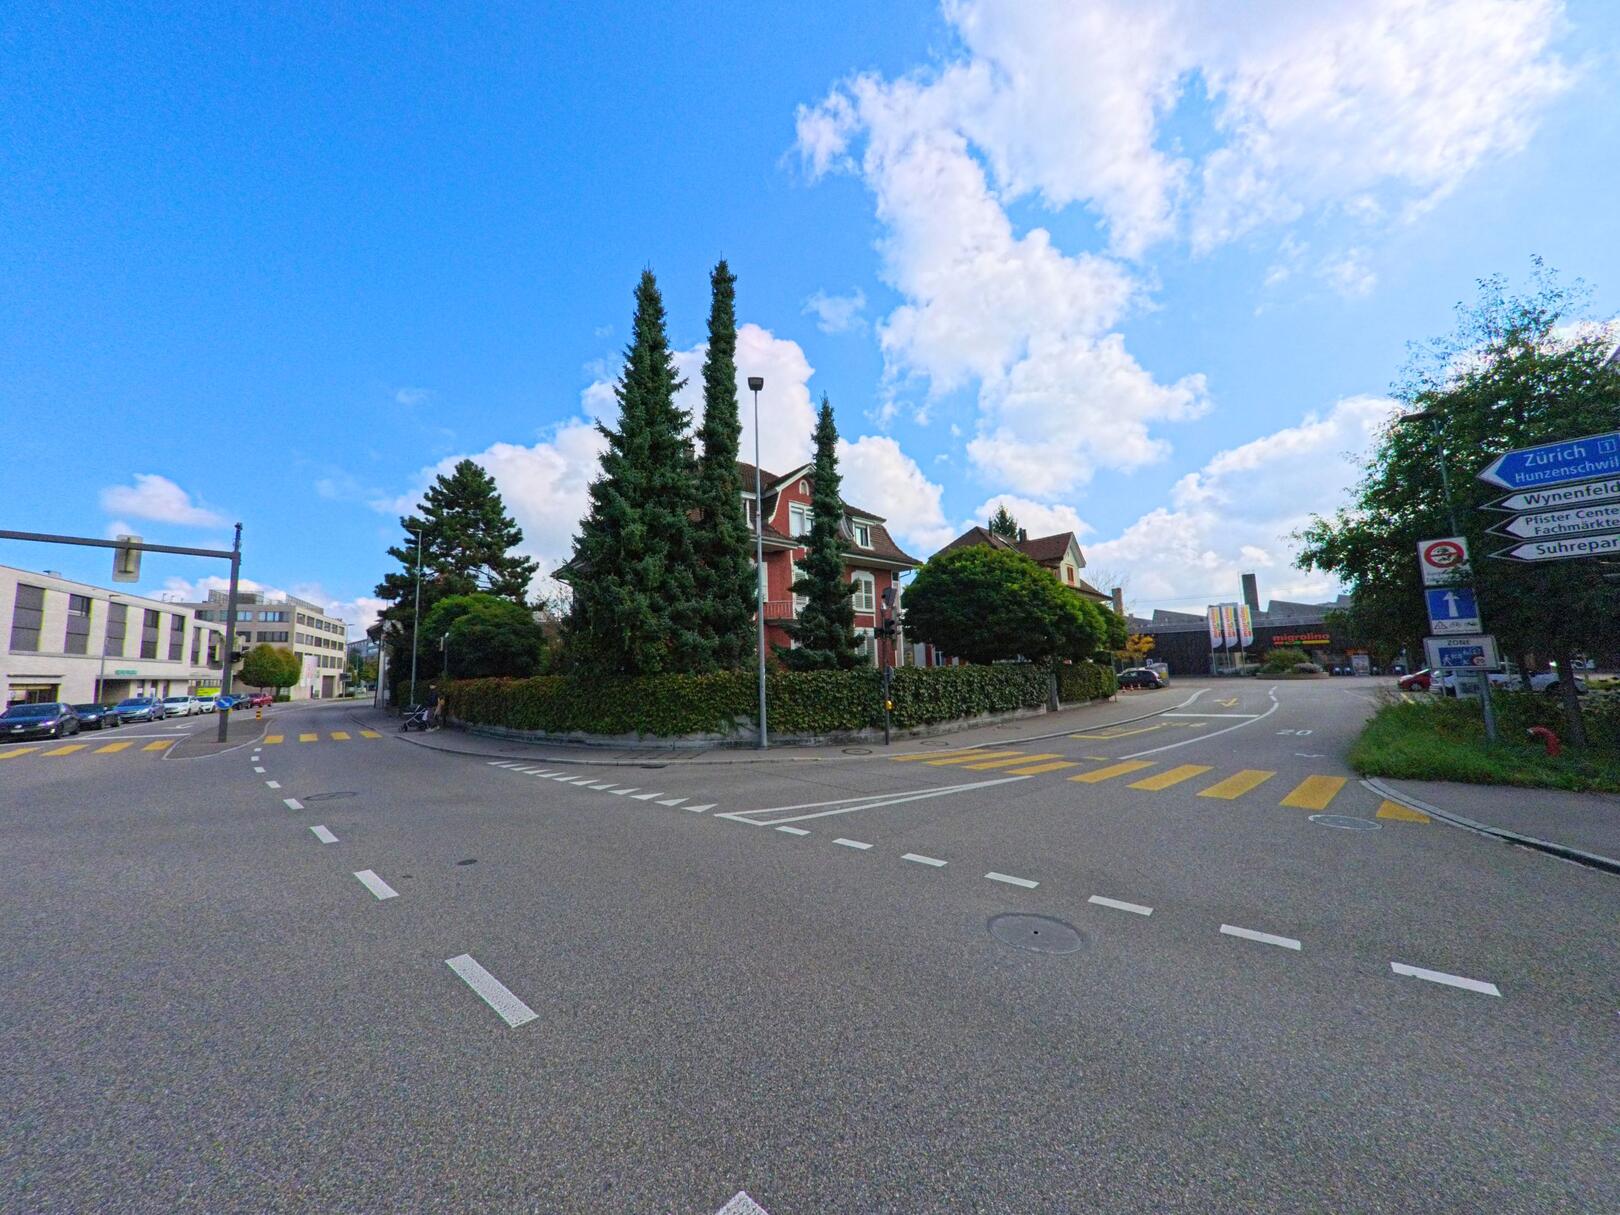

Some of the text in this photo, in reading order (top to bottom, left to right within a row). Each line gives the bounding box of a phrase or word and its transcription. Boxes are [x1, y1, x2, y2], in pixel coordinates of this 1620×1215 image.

[1524, 445, 1586, 467] Zürich
[1515, 456, 1620, 483] Hunzenschwil
[1524, 480, 1620, 505] Wynenfeld
[1525, 512, 1571, 526] Pfister
[1272, 632, 1330, 644] migrolino
